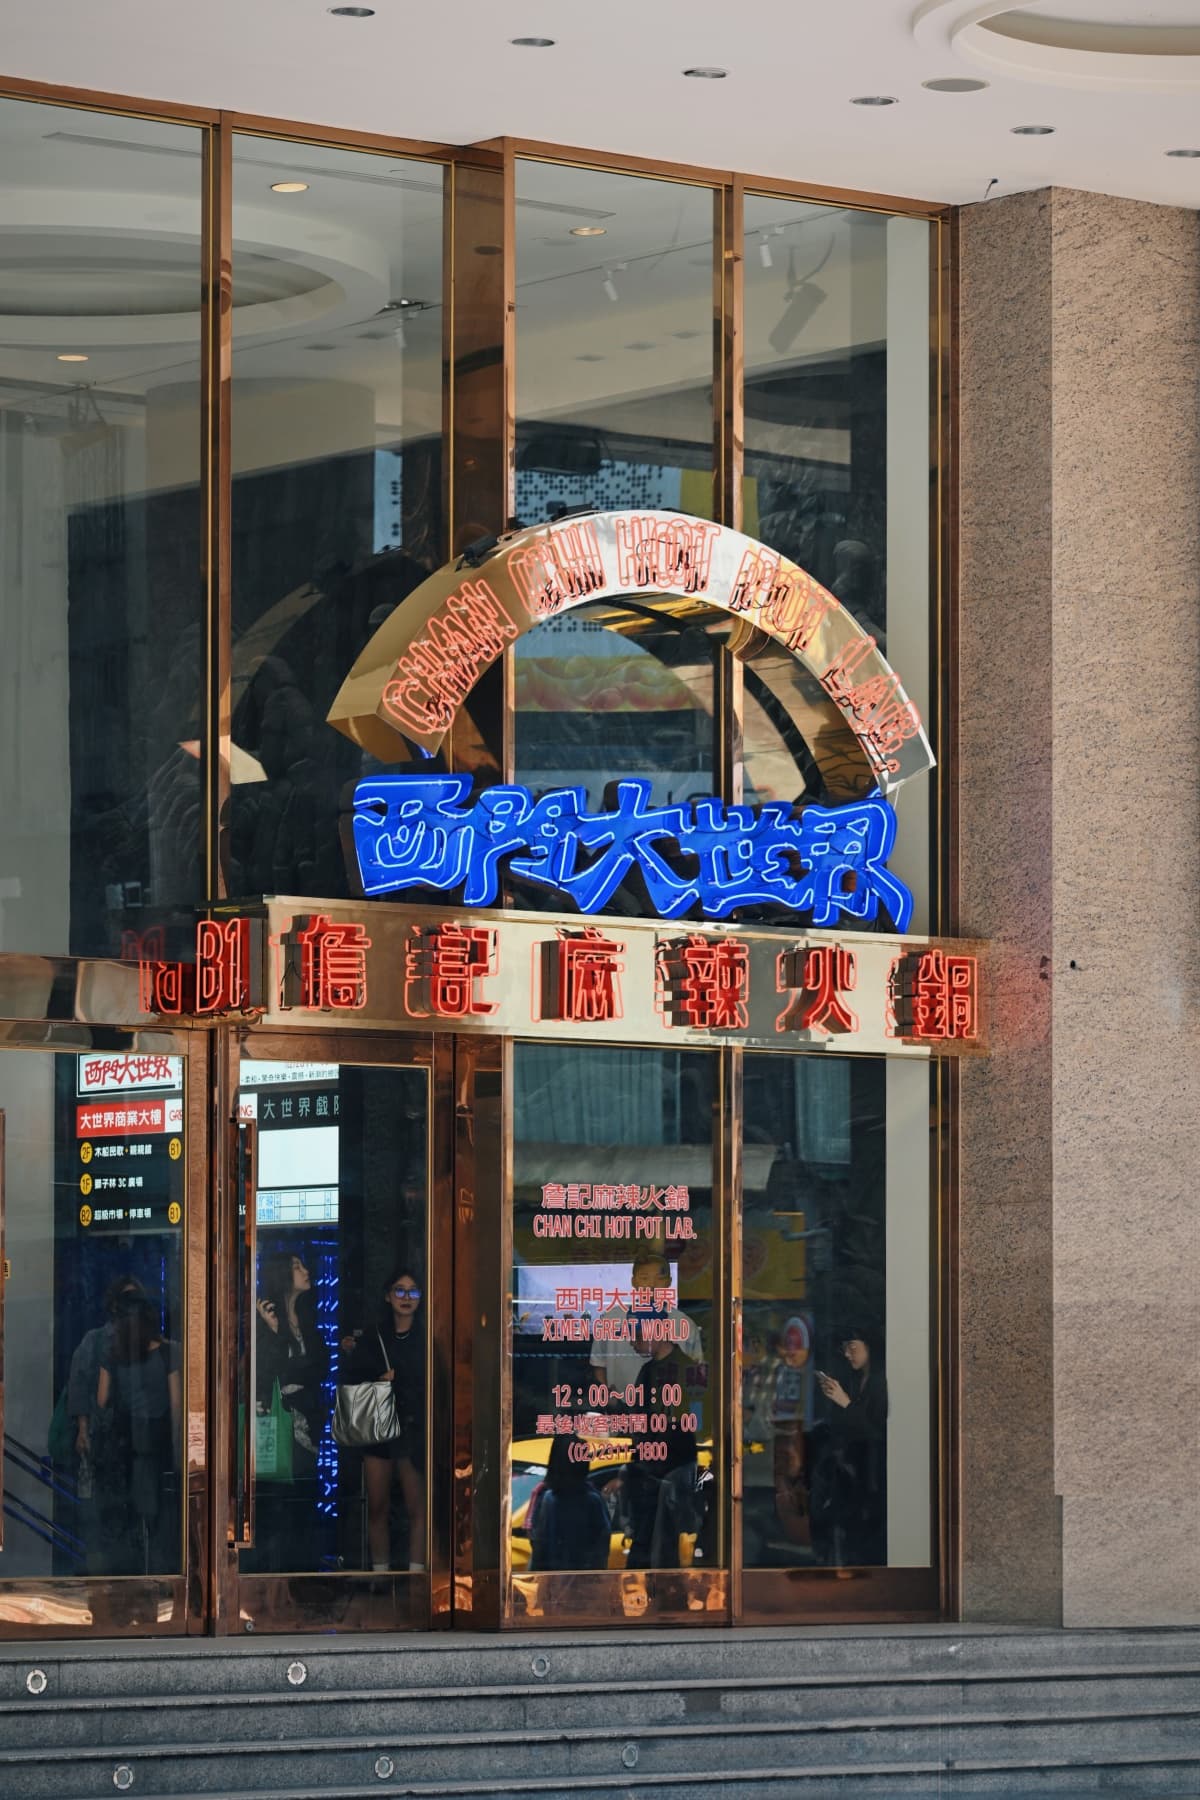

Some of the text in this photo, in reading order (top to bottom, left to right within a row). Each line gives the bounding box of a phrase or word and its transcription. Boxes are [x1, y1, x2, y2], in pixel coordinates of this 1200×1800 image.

[382, 578, 518, 734] CHAN
[507, 522, 606, 616] CHI
[617, 516, 722, 592] HOT
[730, 548, 841, 651] POT
[196, 917, 249, 1013] B1
[85, 1055, 172, 1086] 西門大世界
[541, 1182, 690, 1211] 詹記麻辣火鍋
[533, 1214, 698, 1240] CHAN CHI HOT POT LAB.
[555, 1287, 678, 1313] 西門大世界
[542, 1319, 690, 1341] XIMEN GREAT WORLD
